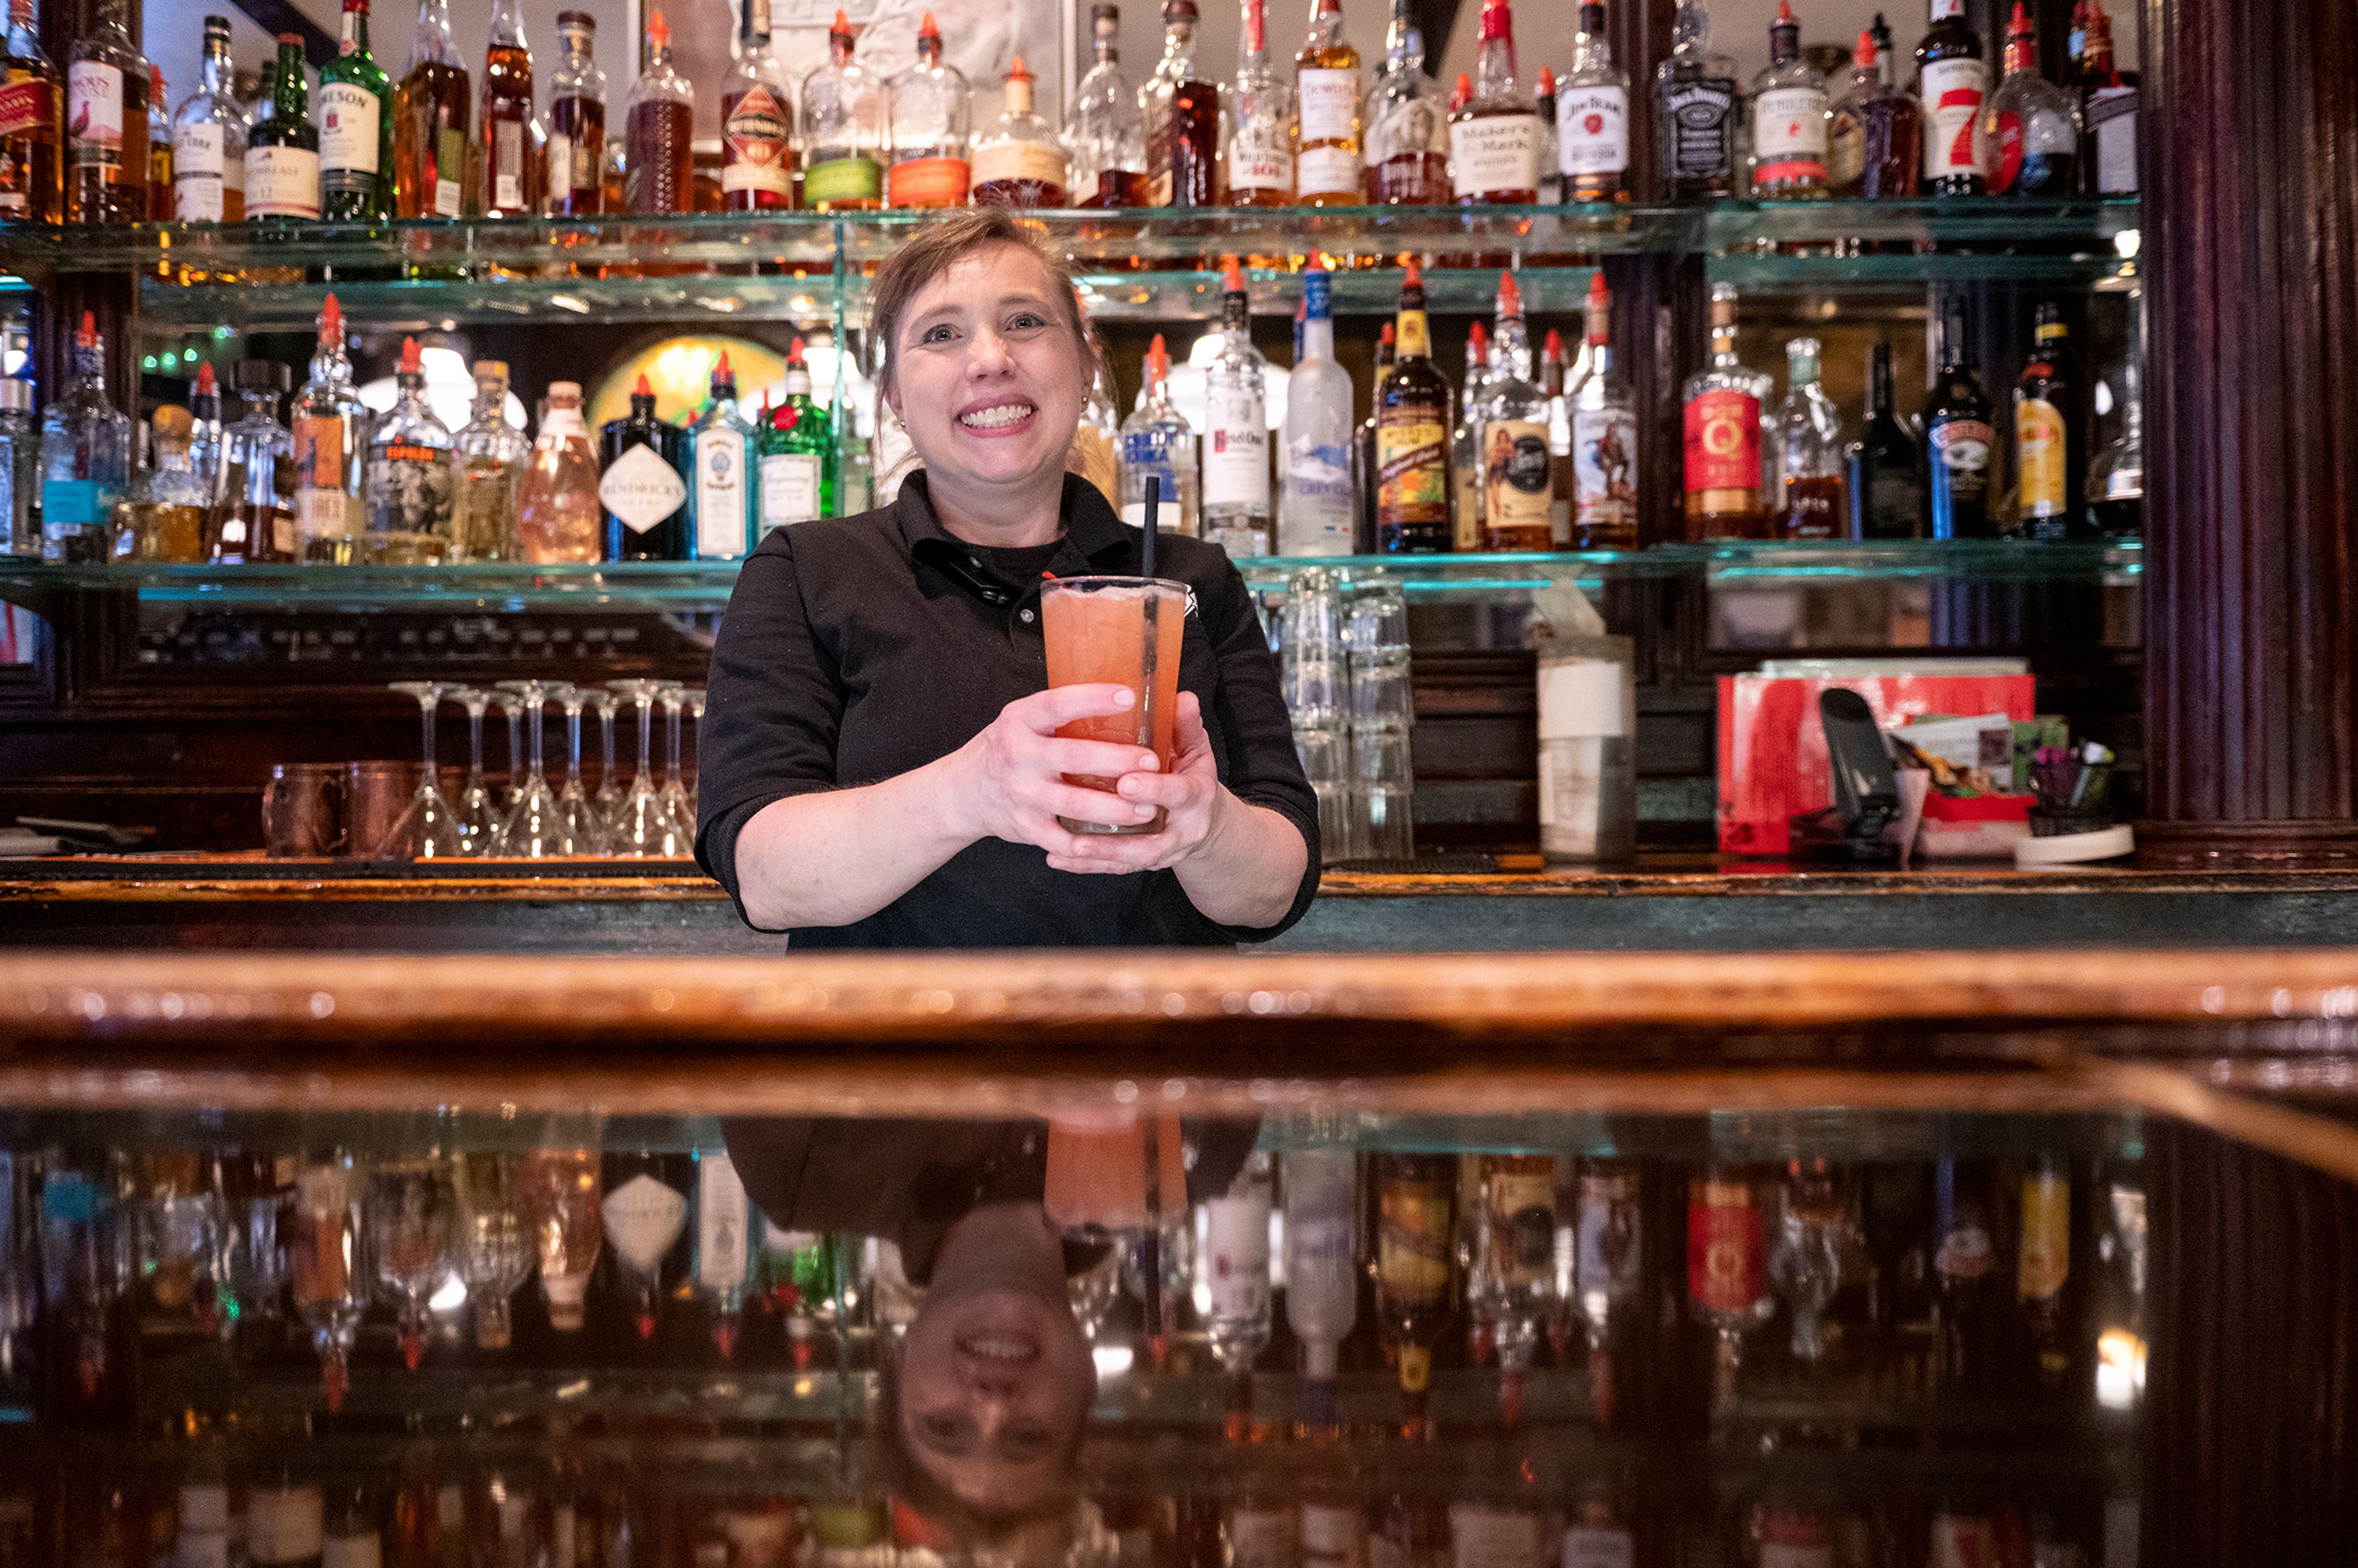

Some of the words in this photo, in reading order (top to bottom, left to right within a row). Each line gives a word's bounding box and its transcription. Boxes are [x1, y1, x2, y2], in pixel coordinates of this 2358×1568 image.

[1565, 101, 1587, 122] JIM
[1589, 96, 1621, 118] BEAM
[1462, 125, 1531, 141] Maker's
[1936, 88, 1983, 166] 7
[1482, 139, 1530, 152] Mark
[1702, 417, 1743, 461] Q
